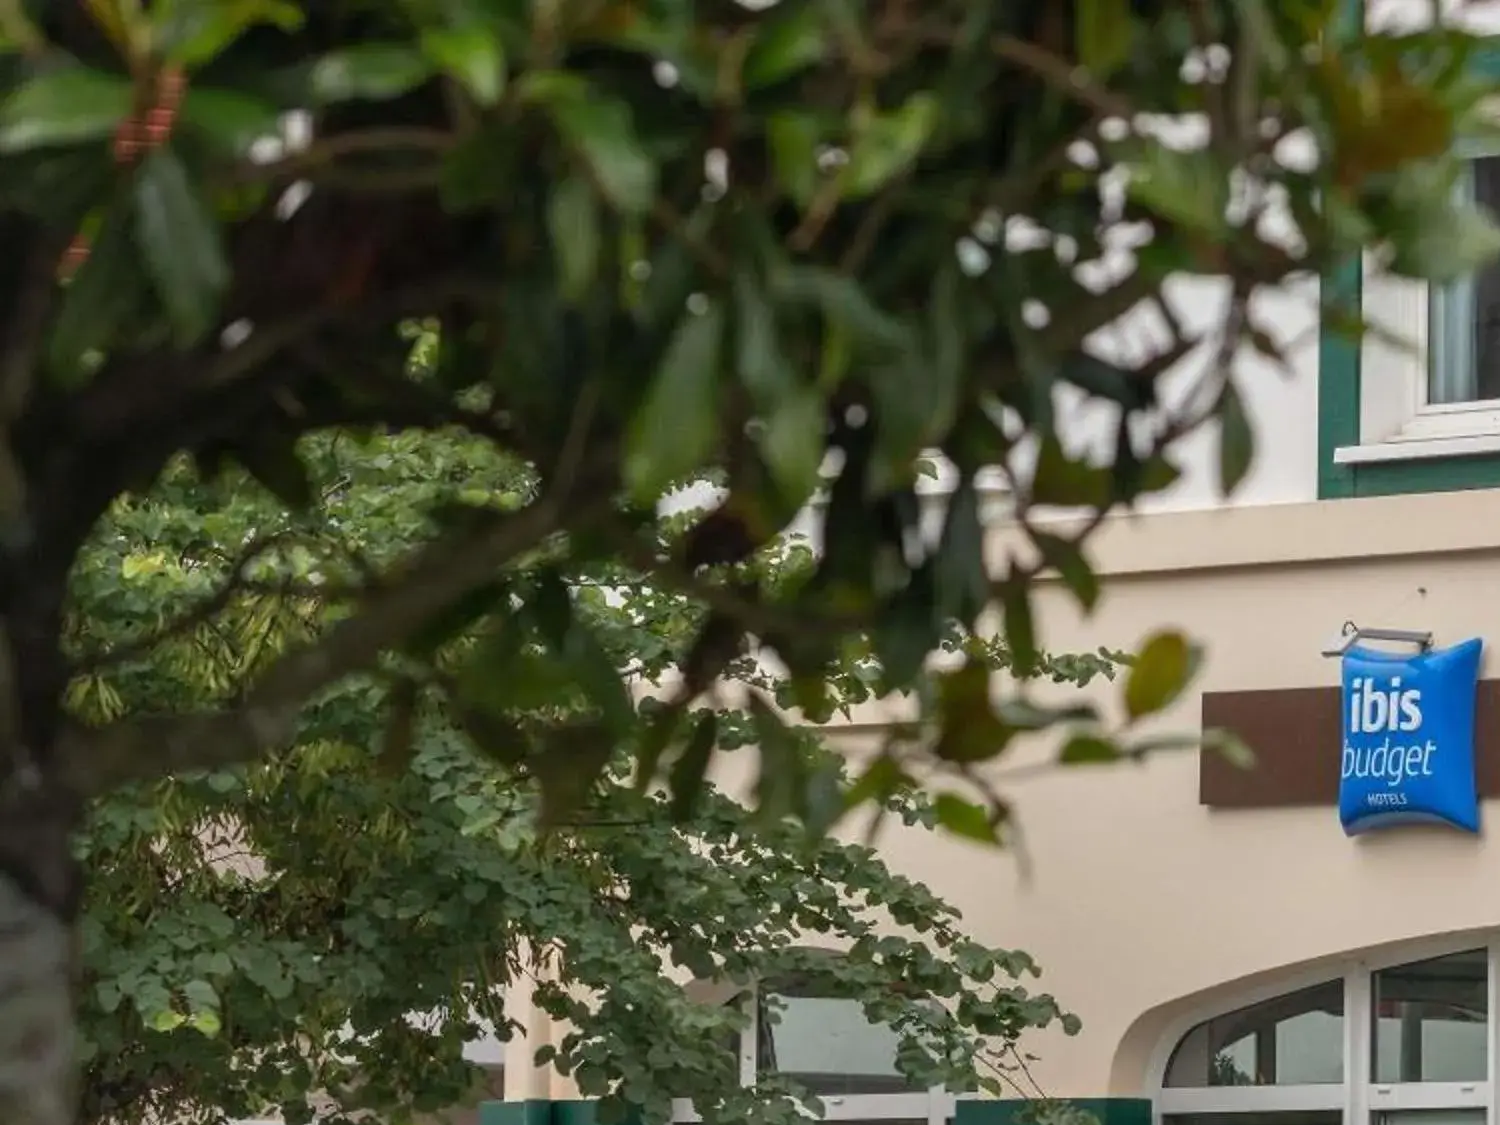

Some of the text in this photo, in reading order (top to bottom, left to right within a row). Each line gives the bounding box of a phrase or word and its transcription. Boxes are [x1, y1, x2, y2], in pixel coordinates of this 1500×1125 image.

[1351, 675, 1423, 733] ibis
[1341, 737, 1437, 787] budget
[1367, 792, 1408, 807] HOTELS
